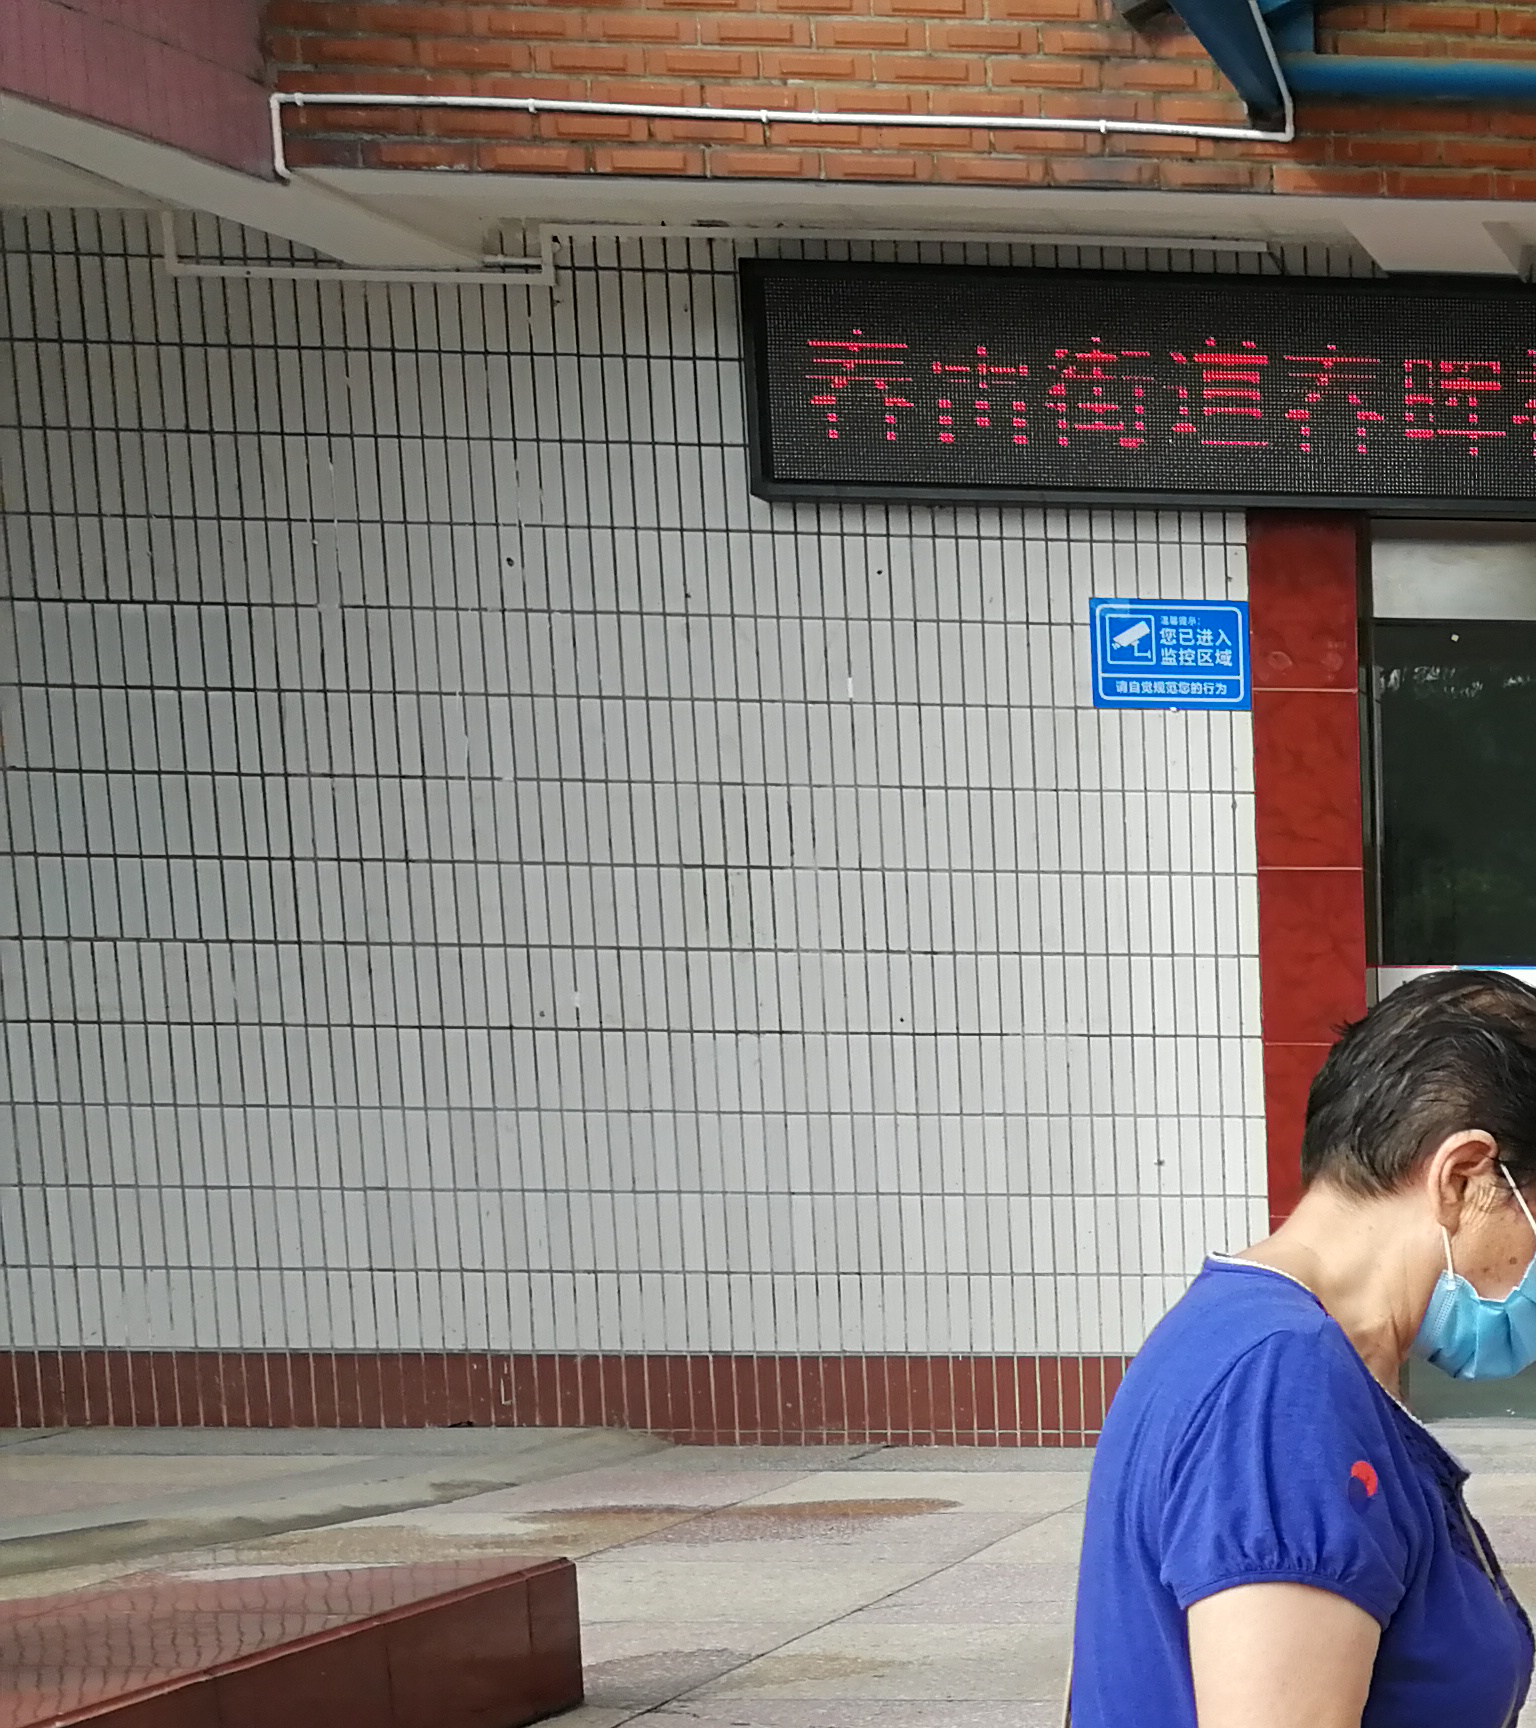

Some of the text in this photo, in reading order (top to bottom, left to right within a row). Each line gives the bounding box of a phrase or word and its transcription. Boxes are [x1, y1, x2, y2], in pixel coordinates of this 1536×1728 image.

[1160, 628, 1232, 646] 您已进入
[1160, 648, 1232, 666] 监控区域
[1116, 681, 1227, 695] 请自觉规范您的行为
